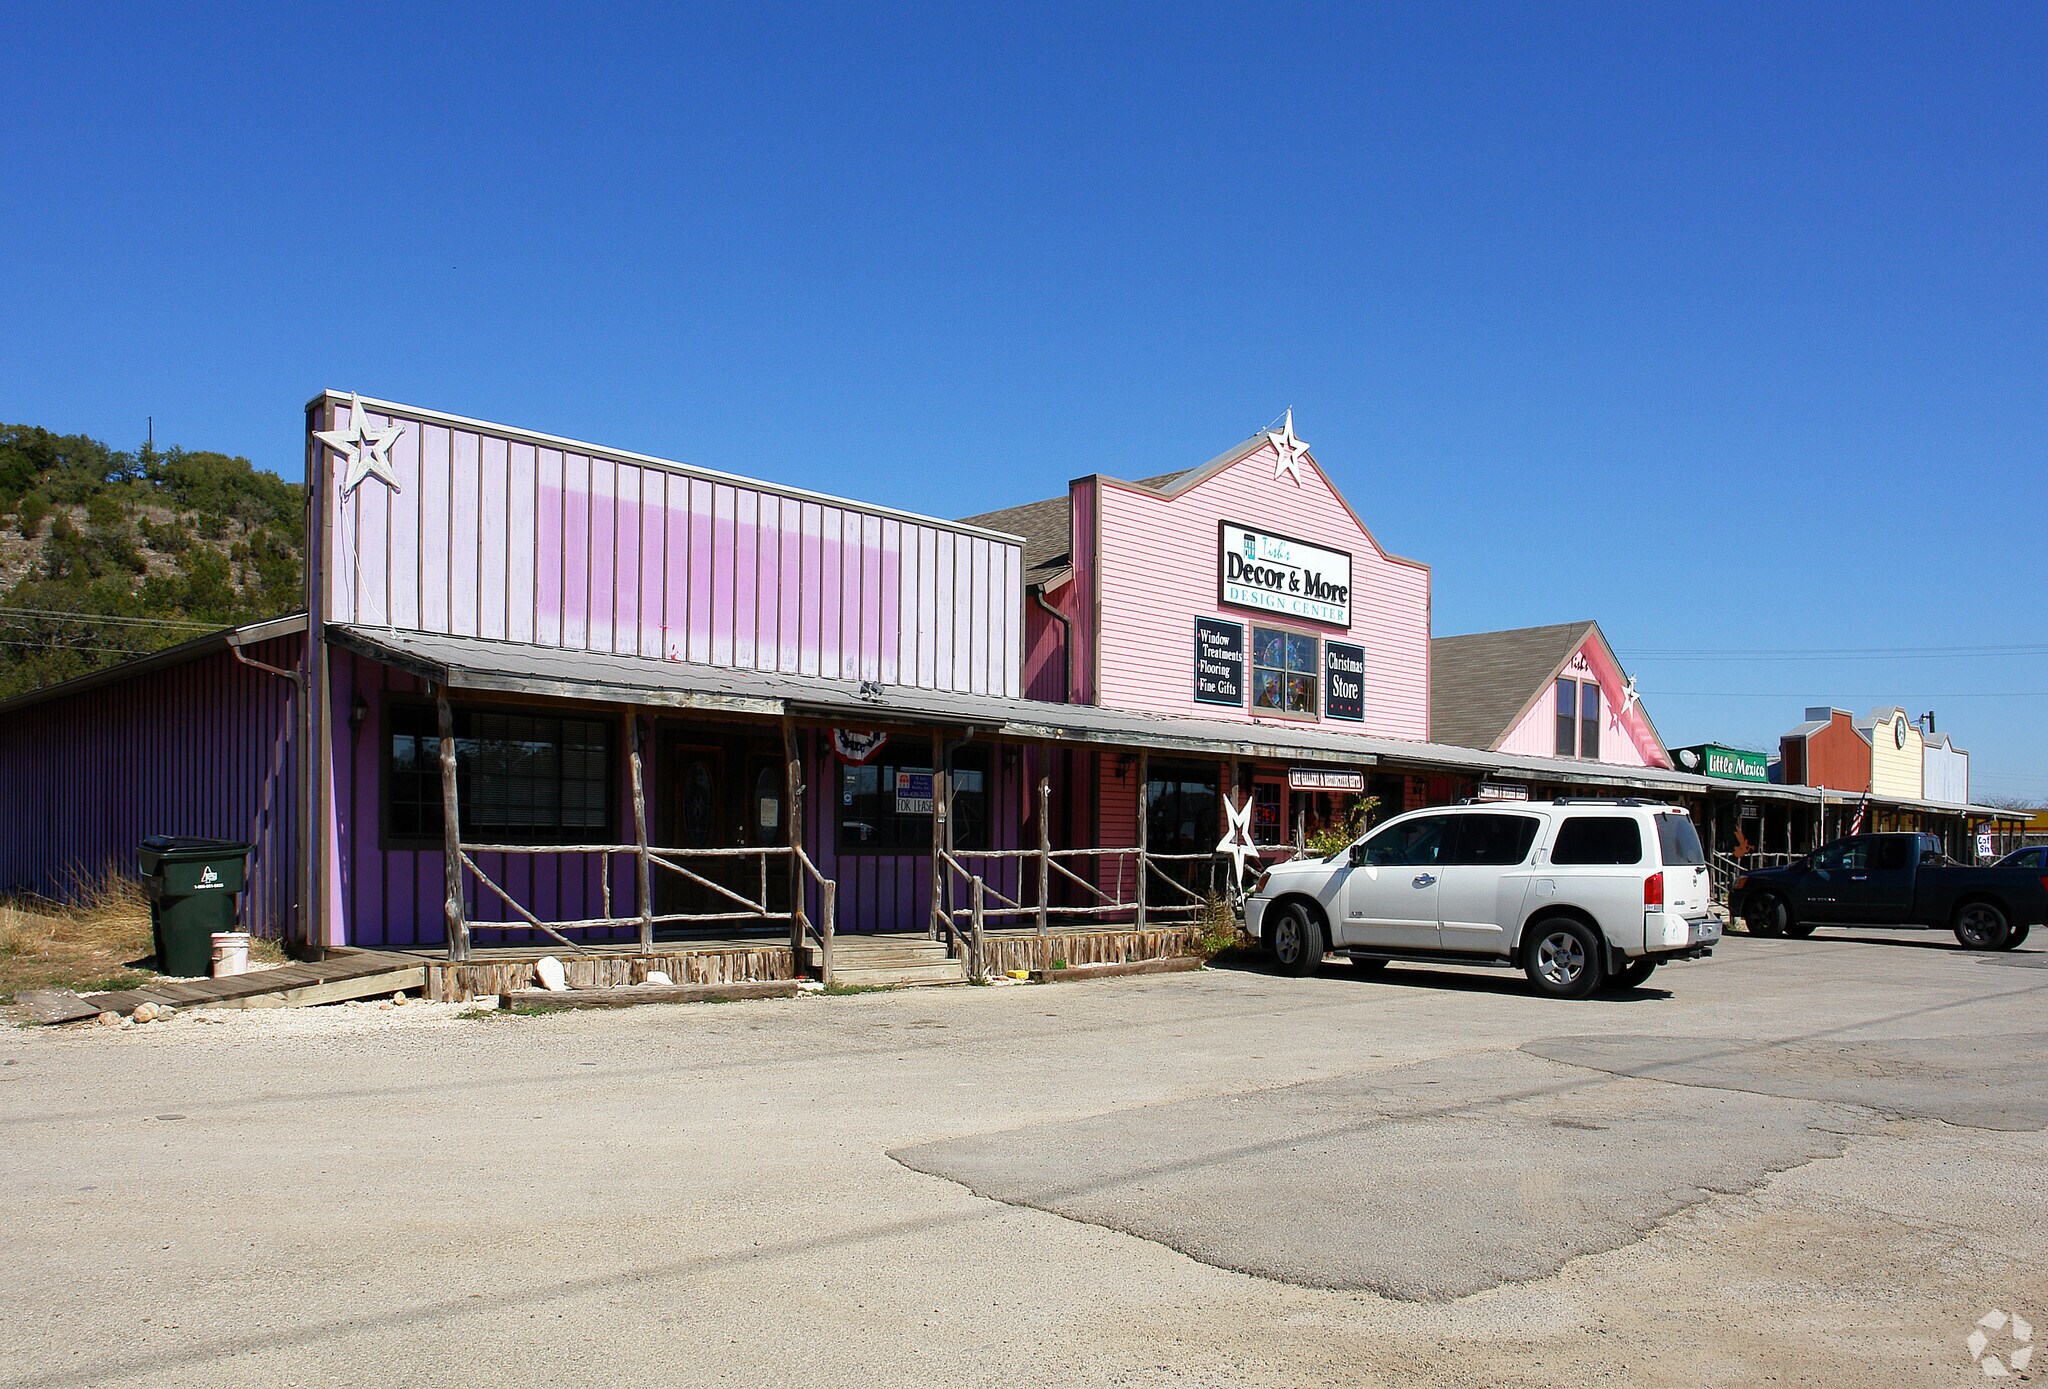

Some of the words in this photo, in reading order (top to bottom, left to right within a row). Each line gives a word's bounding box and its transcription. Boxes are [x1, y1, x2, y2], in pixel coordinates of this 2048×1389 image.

[1227, 551, 1285, 590] Decor
[1289, 571, 1300, 592] &
[1304, 570, 1348, 604] More
[1230, 587, 1285, 609] DESIGN
[1293, 600, 1344, 621] CENTER
[1200, 629, 1230, 645] Window
[1203, 644, 1243, 662] Treatments
[1328, 652, 1363, 673] Christmas
[1200, 659, 1230, 678] Flooring
[1199, 677, 1216, 692] Fine
[1217, 680, 1236, 695] Gifts
[1332, 674, 1359, 700] Store
[1709, 754, 1734, 774] Little
[1735, 758, 1765, 777] Mexico
[897, 799, 911, 811] FOR
[914, 800, 933, 812] LEASE
